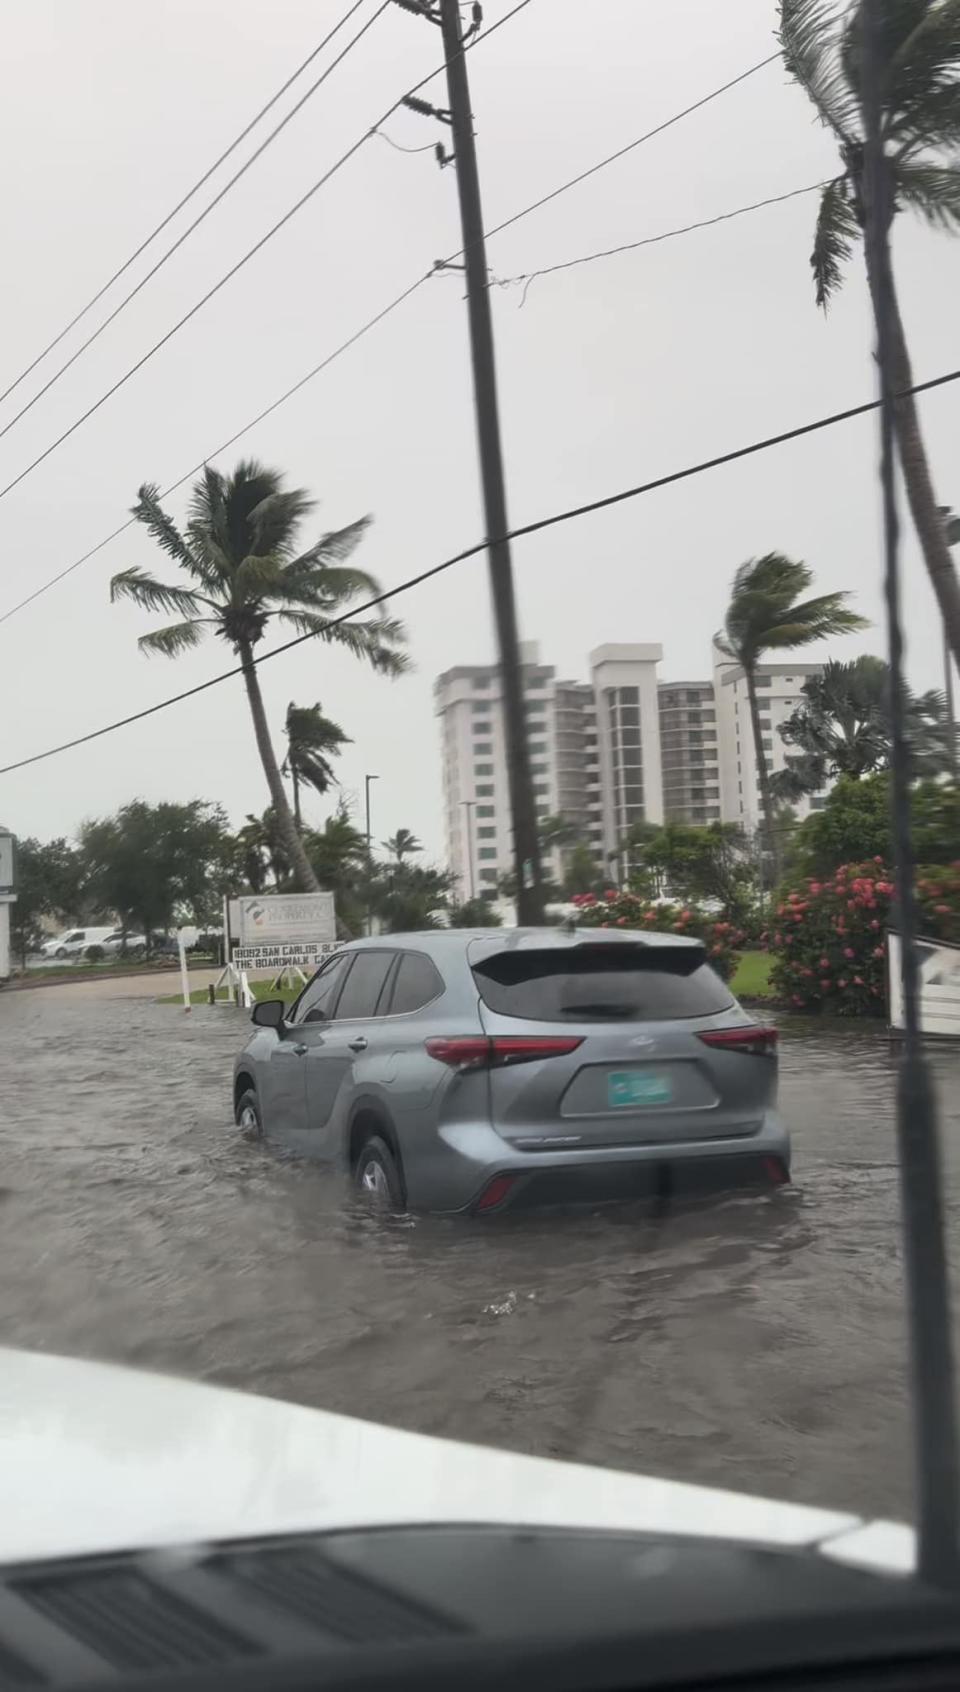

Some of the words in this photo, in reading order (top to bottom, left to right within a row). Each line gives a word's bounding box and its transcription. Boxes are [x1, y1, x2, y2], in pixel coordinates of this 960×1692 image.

[262, 947, 280, 957] SAN
[282, 945, 318, 956] CARLOS
[235, 959, 253, 969] THE
[255, 955, 309, 968] BOARDWALK
